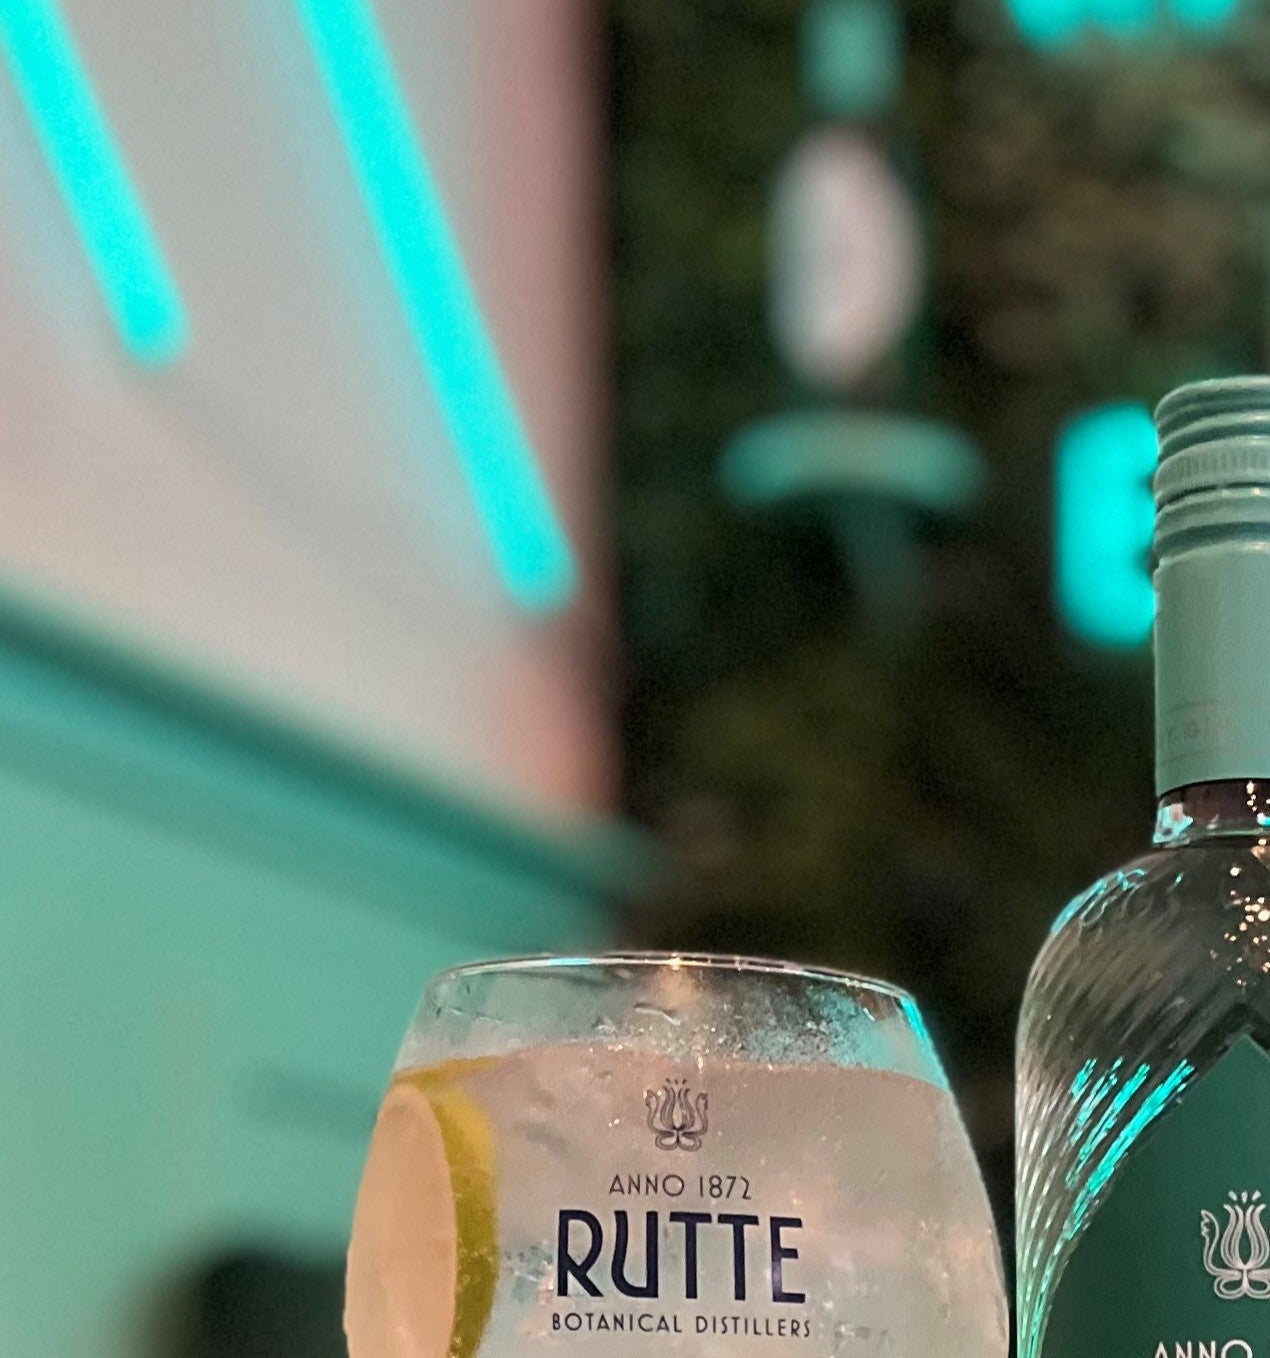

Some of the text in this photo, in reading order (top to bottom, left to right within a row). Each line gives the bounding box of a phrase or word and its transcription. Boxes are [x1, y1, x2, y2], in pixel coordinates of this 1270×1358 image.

[609, 1174, 752, 1201] ANNO 1872
[557, 1209, 806, 1304] RUTTE
[551, 1312, 812, 1338] BOTANICAL DISTILLERS
